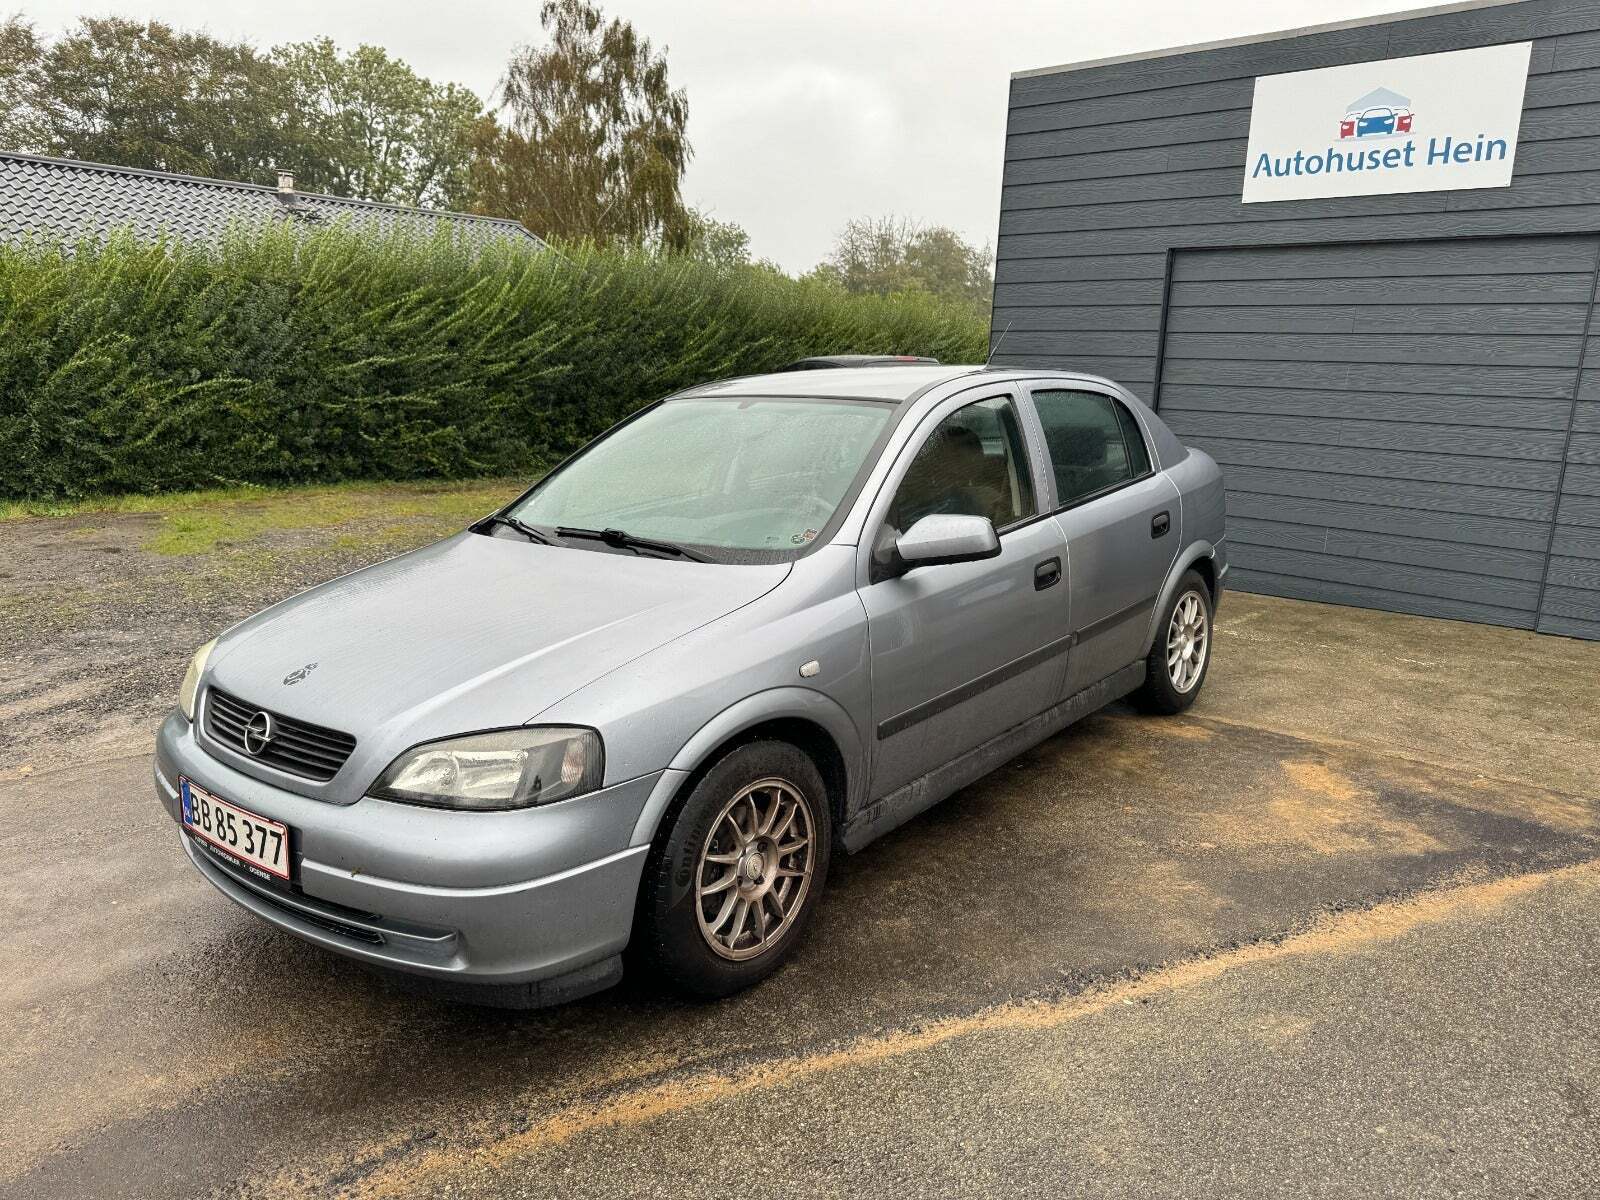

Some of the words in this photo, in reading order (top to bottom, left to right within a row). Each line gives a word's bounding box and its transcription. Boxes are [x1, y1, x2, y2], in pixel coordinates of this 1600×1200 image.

[1252, 140, 1416, 179] Autohuset
[1427, 133, 1507, 166] Hein
[191, 792, 212, 832] BB
[215, 806, 238, 847] 85
[242, 819, 283, 865] 377
